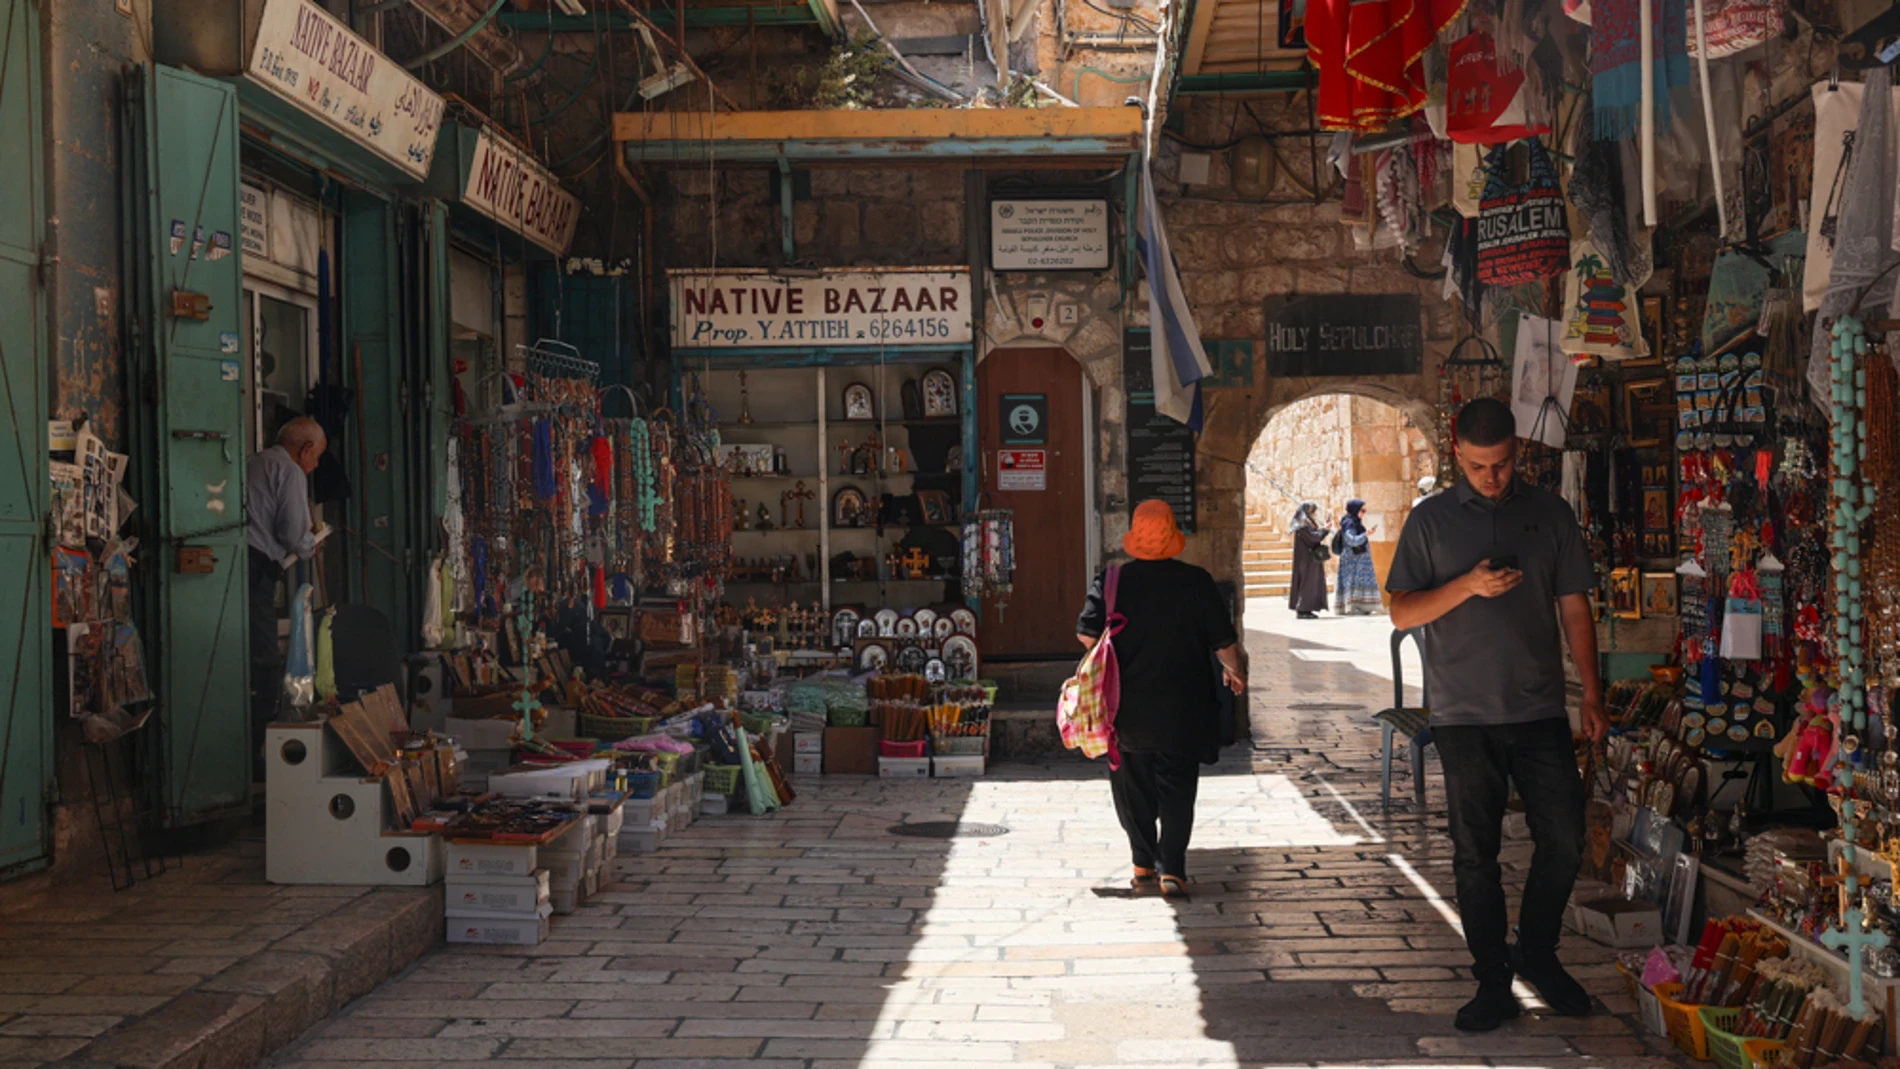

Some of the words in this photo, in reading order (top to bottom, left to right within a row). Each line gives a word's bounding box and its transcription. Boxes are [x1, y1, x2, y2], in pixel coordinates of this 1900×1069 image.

[290, 3, 333, 66] NATIVE
[328, 31, 375, 96] BAZAAR
[476, 147, 529, 219] NATIVE
[524, 180, 572, 246] BAZAAR
[685, 287, 803, 315] NATIVE
[824, 287, 959, 315] BAZAAR
[1065, 307, 1073, 320] 2
[869, 317, 949, 338] 6264156
[1269, 321, 1310, 352] HOLY
